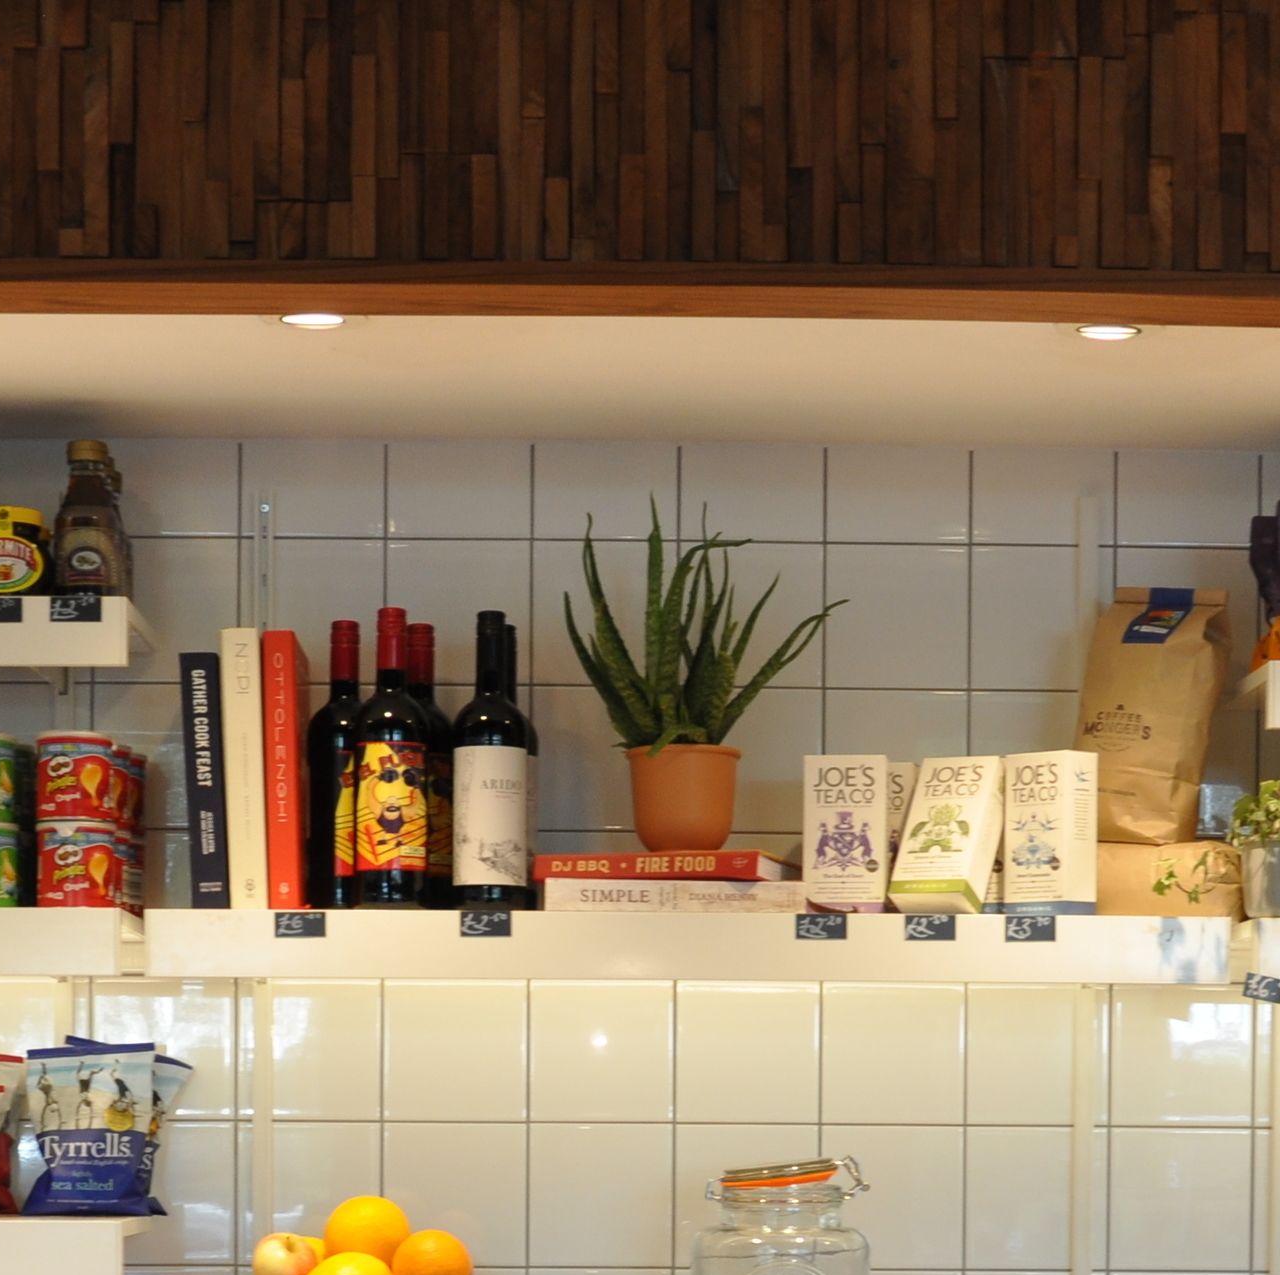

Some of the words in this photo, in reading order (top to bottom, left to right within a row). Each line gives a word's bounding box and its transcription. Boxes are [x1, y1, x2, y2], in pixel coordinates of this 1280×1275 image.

[194, 715, 210, 747] COOK
[273, 652, 288, 823] OTTOLENGHI
[196, 749, 213, 788] FEAST
[813, 764, 876, 788] JOE'S
[925, 764, 984, 784] JOE'S
[1011, 762, 1058, 787] JOE'S
[813, 788, 847, 805] TEA
[923, 782, 953, 798] TEA
[1011, 787, 1038, 804] TEA
[551, 859, 573, 874] DJ
[575, 859, 610, 875] BBQ
[635, 857, 670, 874] FIRE
[674, 854, 717, 873] FOOD
[580, 889, 650, 905] SIMPLE
[50, 1181, 73, 1191] sea
[76, 1178, 115, 1191] salted
